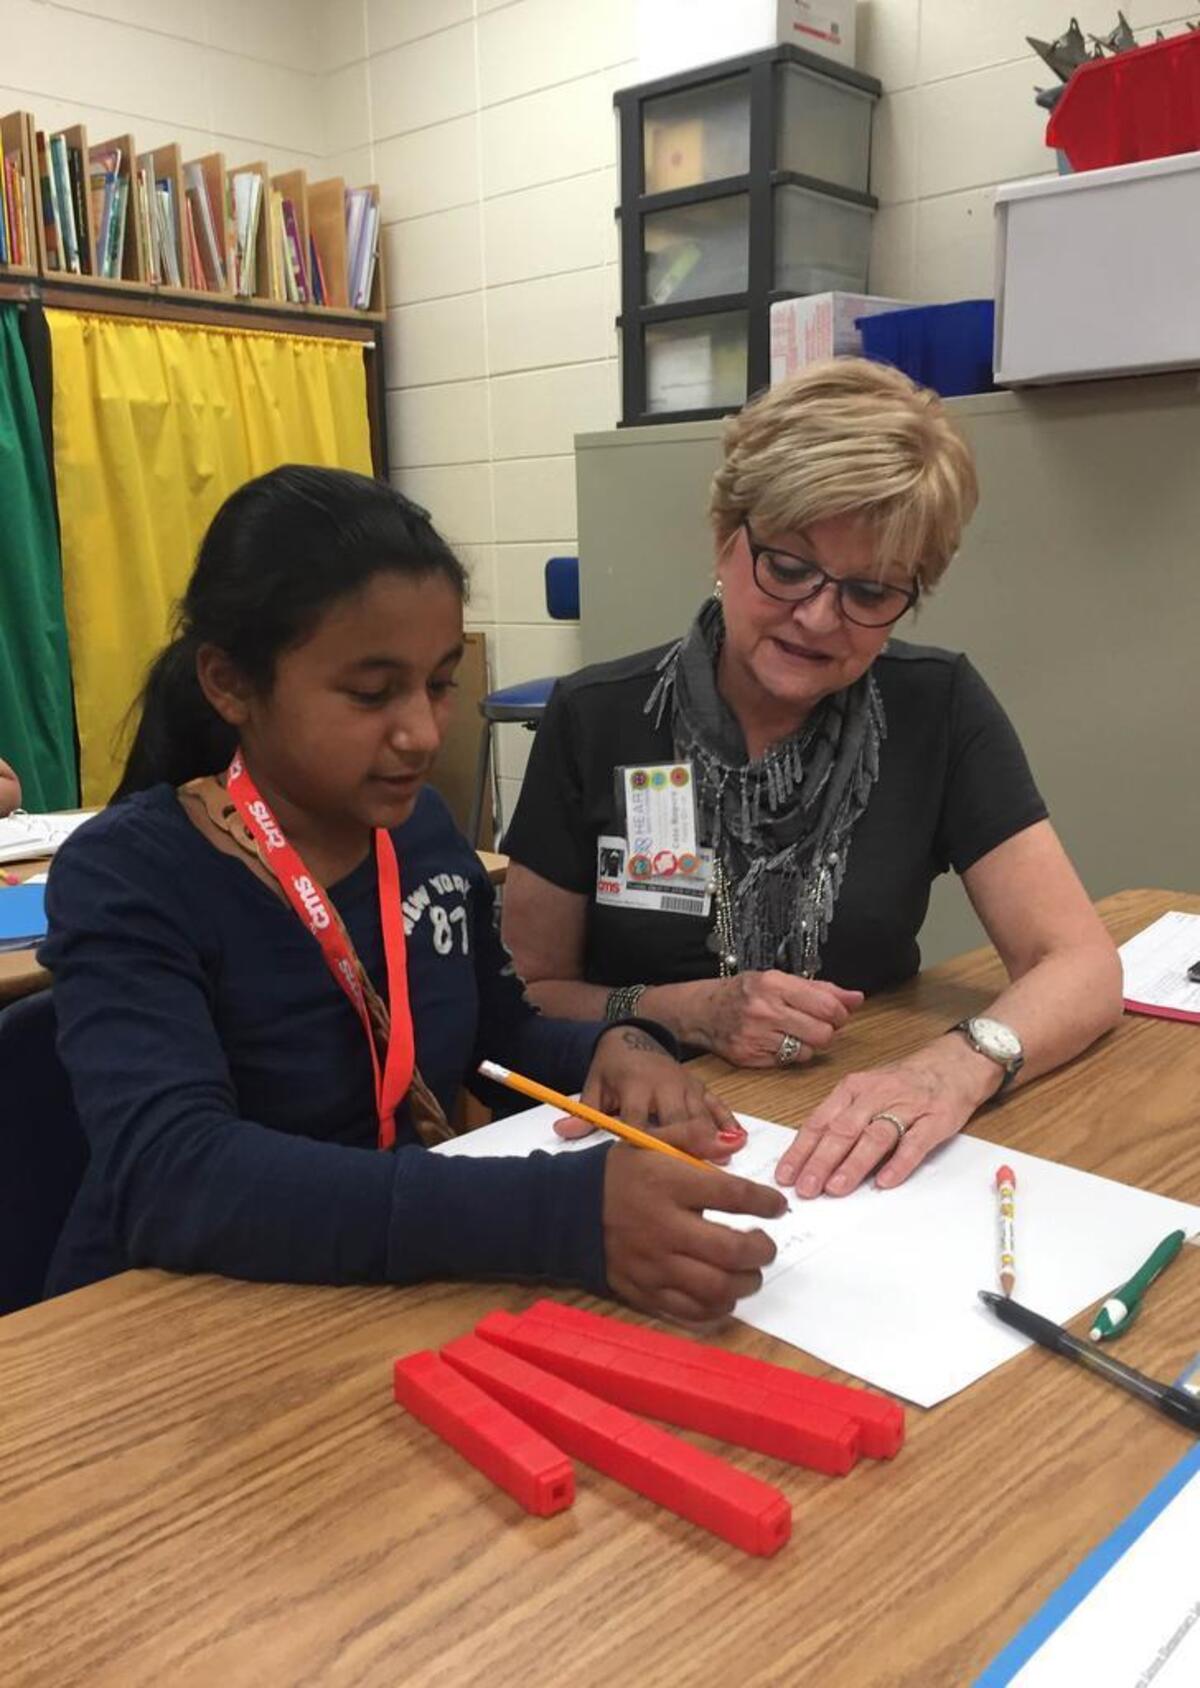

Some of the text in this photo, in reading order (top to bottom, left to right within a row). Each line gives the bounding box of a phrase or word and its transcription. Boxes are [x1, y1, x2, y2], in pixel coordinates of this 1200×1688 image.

[249, 800, 286, 850] cms
[633, 791, 645, 834] HEAR
[294, 875, 330, 931] cms
[429, 905, 469, 955] 87
